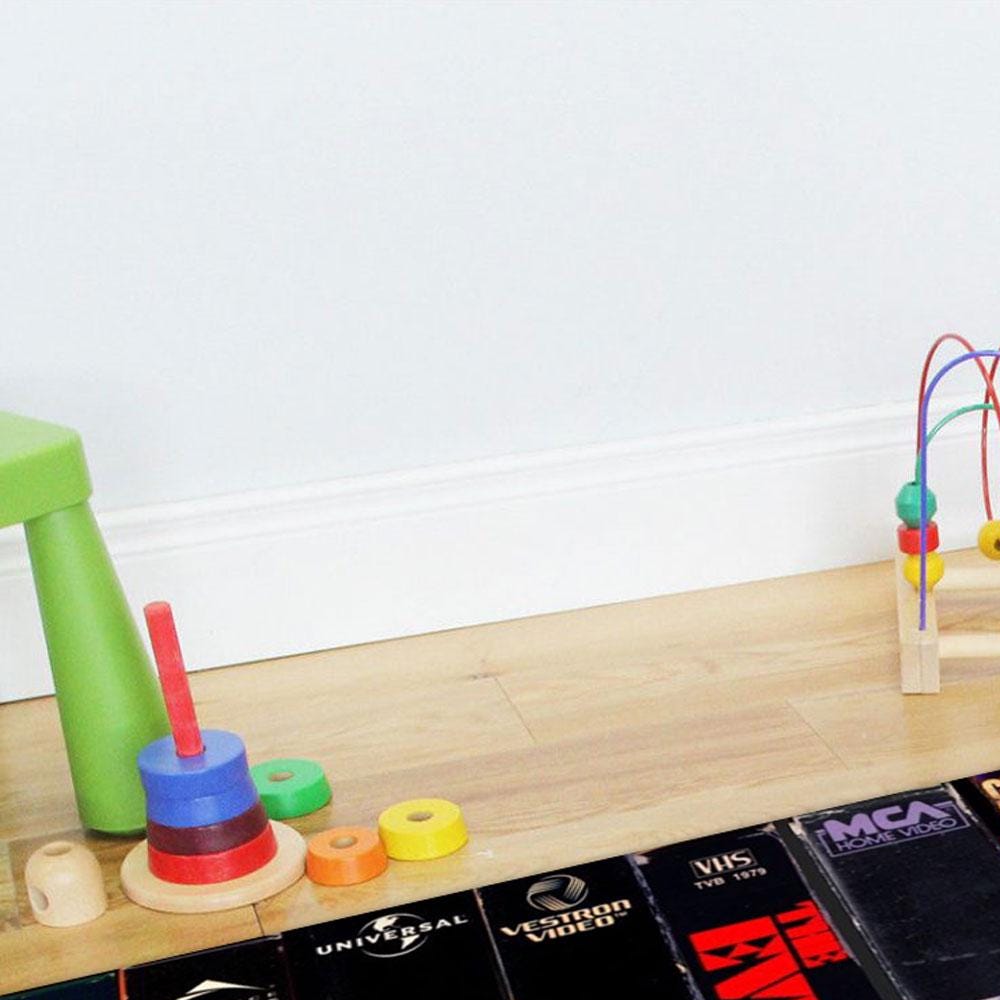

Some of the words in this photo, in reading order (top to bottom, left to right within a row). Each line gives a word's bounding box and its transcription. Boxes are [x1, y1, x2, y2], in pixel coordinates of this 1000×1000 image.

[822, 799, 952, 843] MCA
[835, 828, 897, 853] HOME
[898, 815, 959, 846] VIDEO
[693, 848, 753, 876] VHS
[693, 876, 726, 891] TVB
[732, 866, 768, 881] 1979
[315, 913, 470, 957] UNIVERSAL
[499, 898, 633, 937] VESTRON
[524, 914, 616, 943] VIDEO
[775, 899, 852, 970] THE
